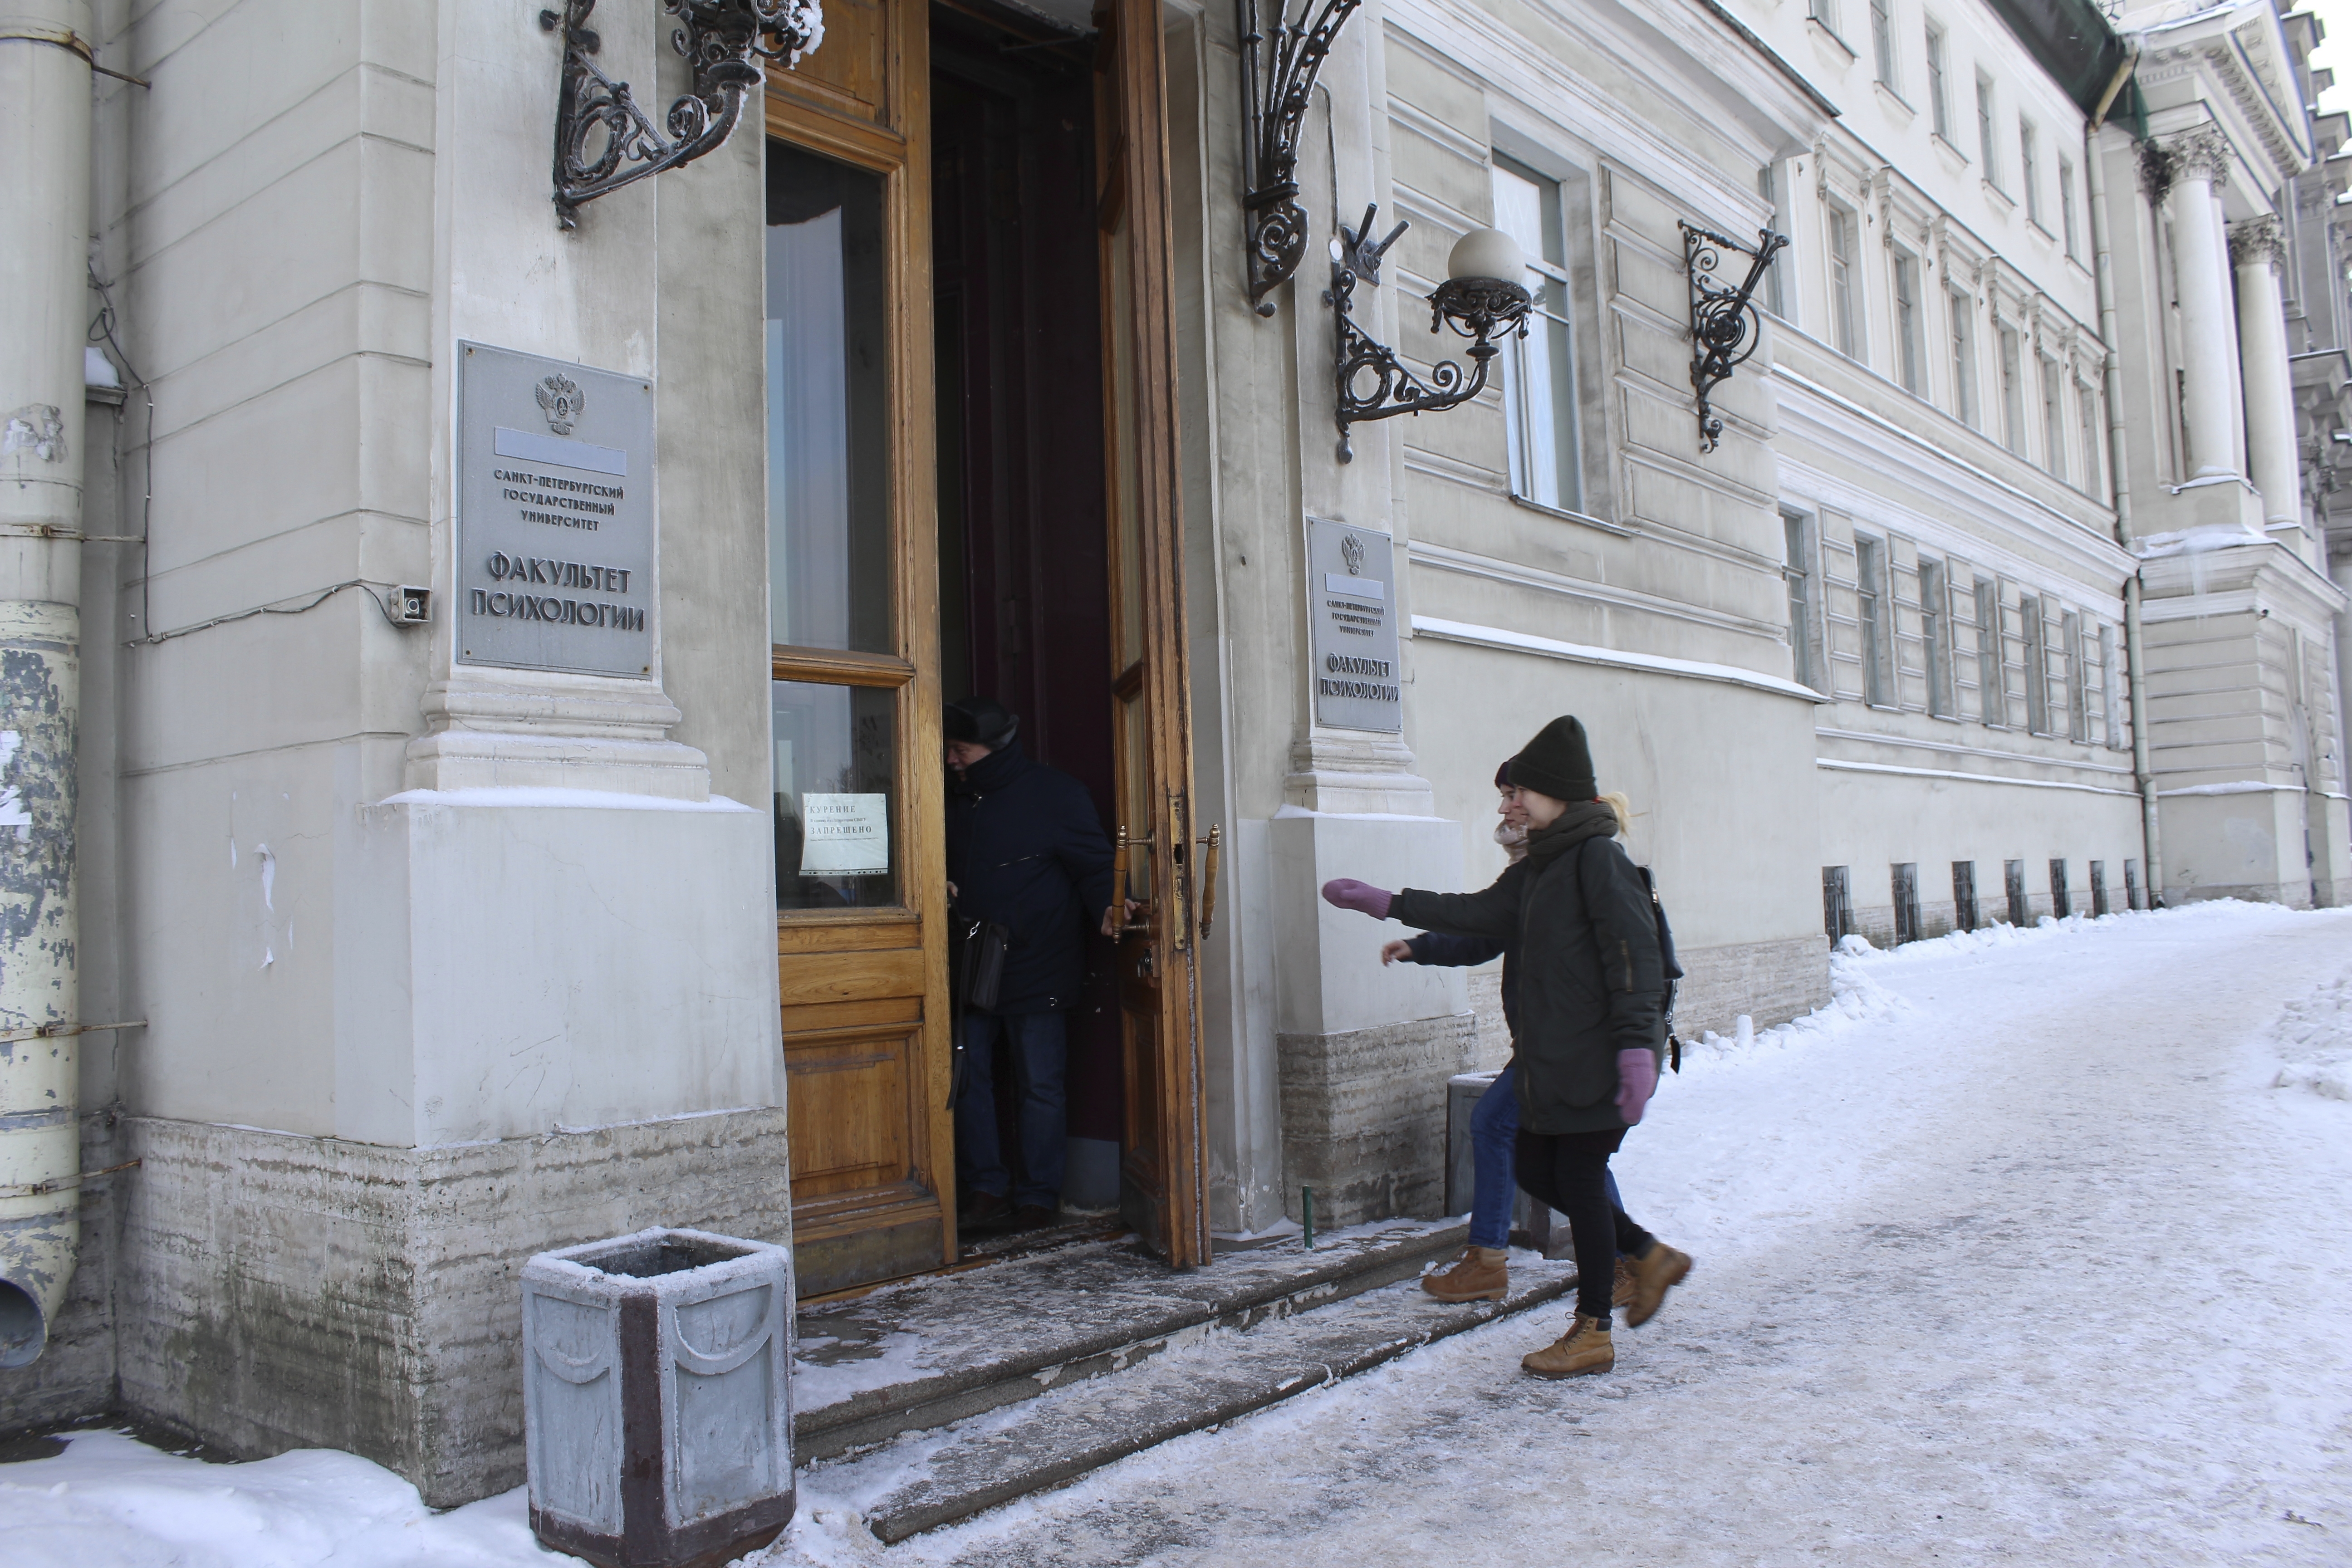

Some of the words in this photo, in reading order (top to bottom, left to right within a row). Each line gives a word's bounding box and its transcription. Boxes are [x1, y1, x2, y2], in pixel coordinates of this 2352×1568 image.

[494, 469, 624, 499] САНКТ-ПЕТЕРБУРГСКИЙ
[504, 488, 615, 515] ГОСУДАРСТВЕННЫЙ
[521, 509, 599, 531] УНИВЕРСИТЕТ
[488, 550, 632, 593] ФАКУЛЬТЕТ
[472, 588, 645, 631] ПСИХОЛОГИИ
[1327, 599, 1385, 615] САНКТ-ПЕТЕРБУРГСКИЙ
[1332, 612, 1382, 626] ГОСУДАРСТВЕННЫЙ
[1339, 625, 1375, 637] УНИВЕРСИТЕТ
[1327, 652, 1392, 677] ФАКУЛЬТЕТ
[1321, 677, 1399, 702] ПСИХОЛОГИИ
[810, 805, 855, 813] КУРЕНИЕ
[810, 826, 872, 834] ЗАПРЕЩЕНО
